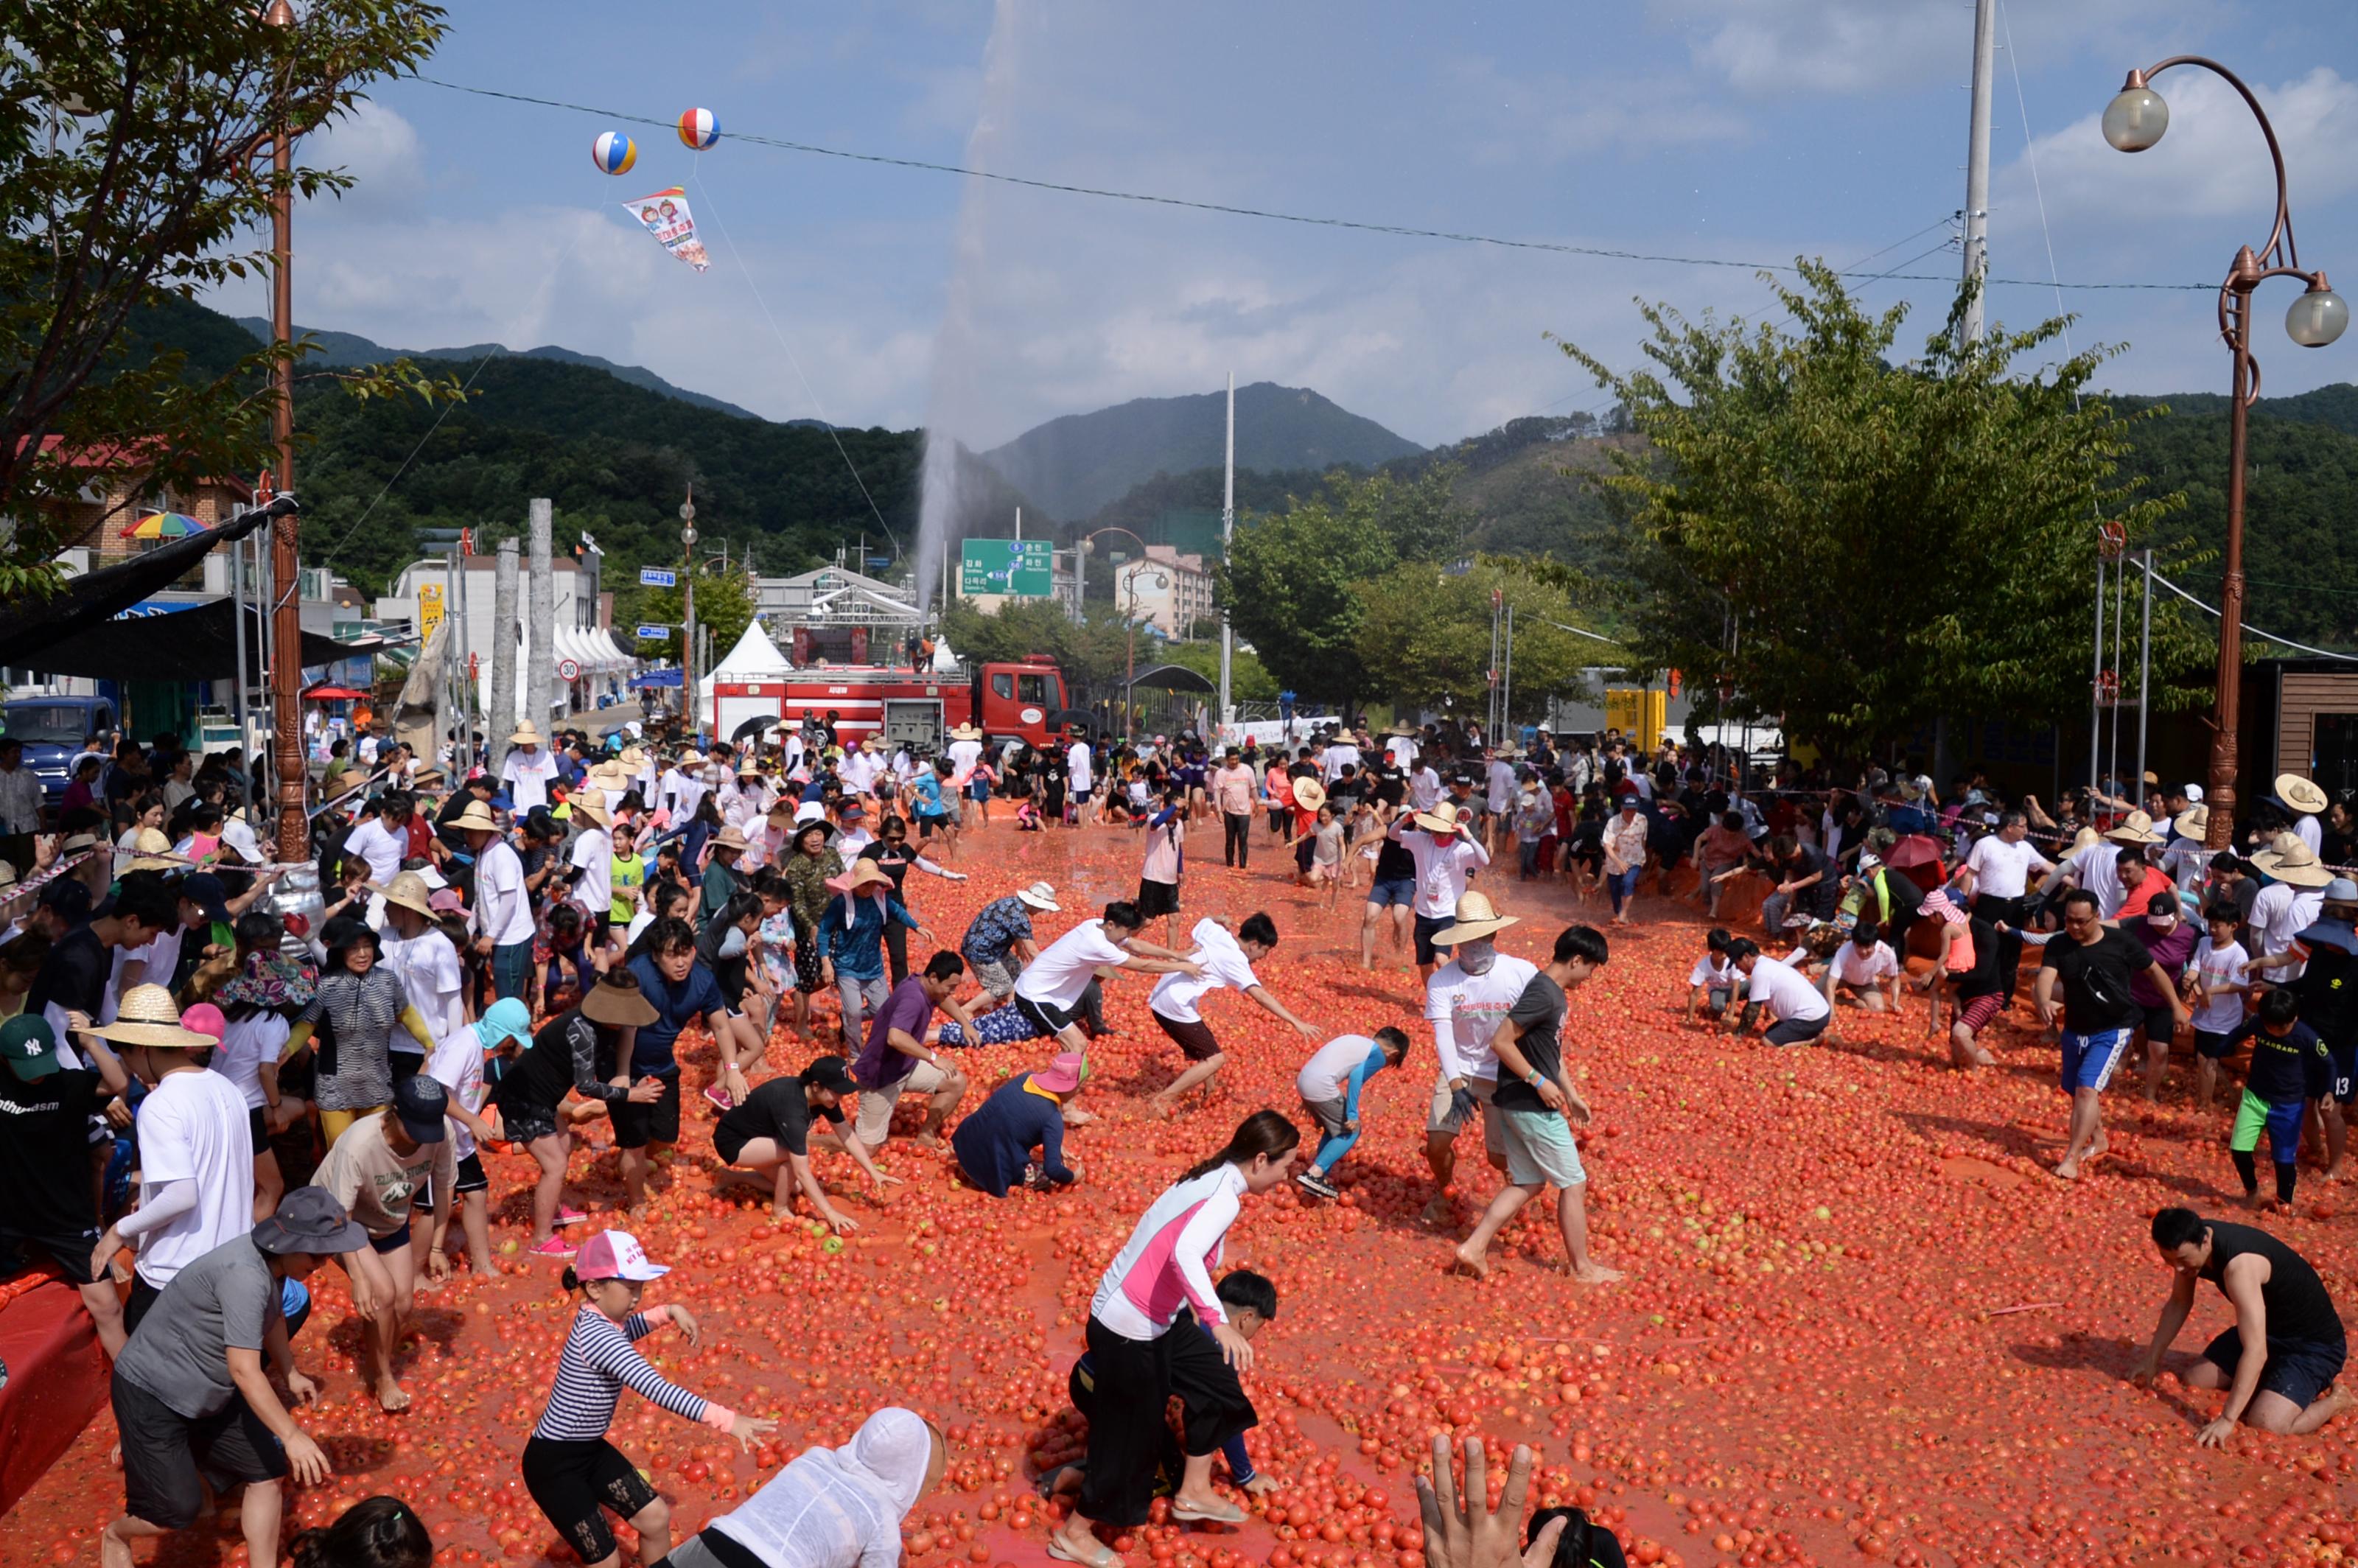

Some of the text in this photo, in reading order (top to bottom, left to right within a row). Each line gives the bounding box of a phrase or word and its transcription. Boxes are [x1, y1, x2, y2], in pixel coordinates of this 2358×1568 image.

[563, 665, 575, 675] 30
[24, 1037, 43, 1056] NY
[2336, 1077, 2350, 1096] 13
